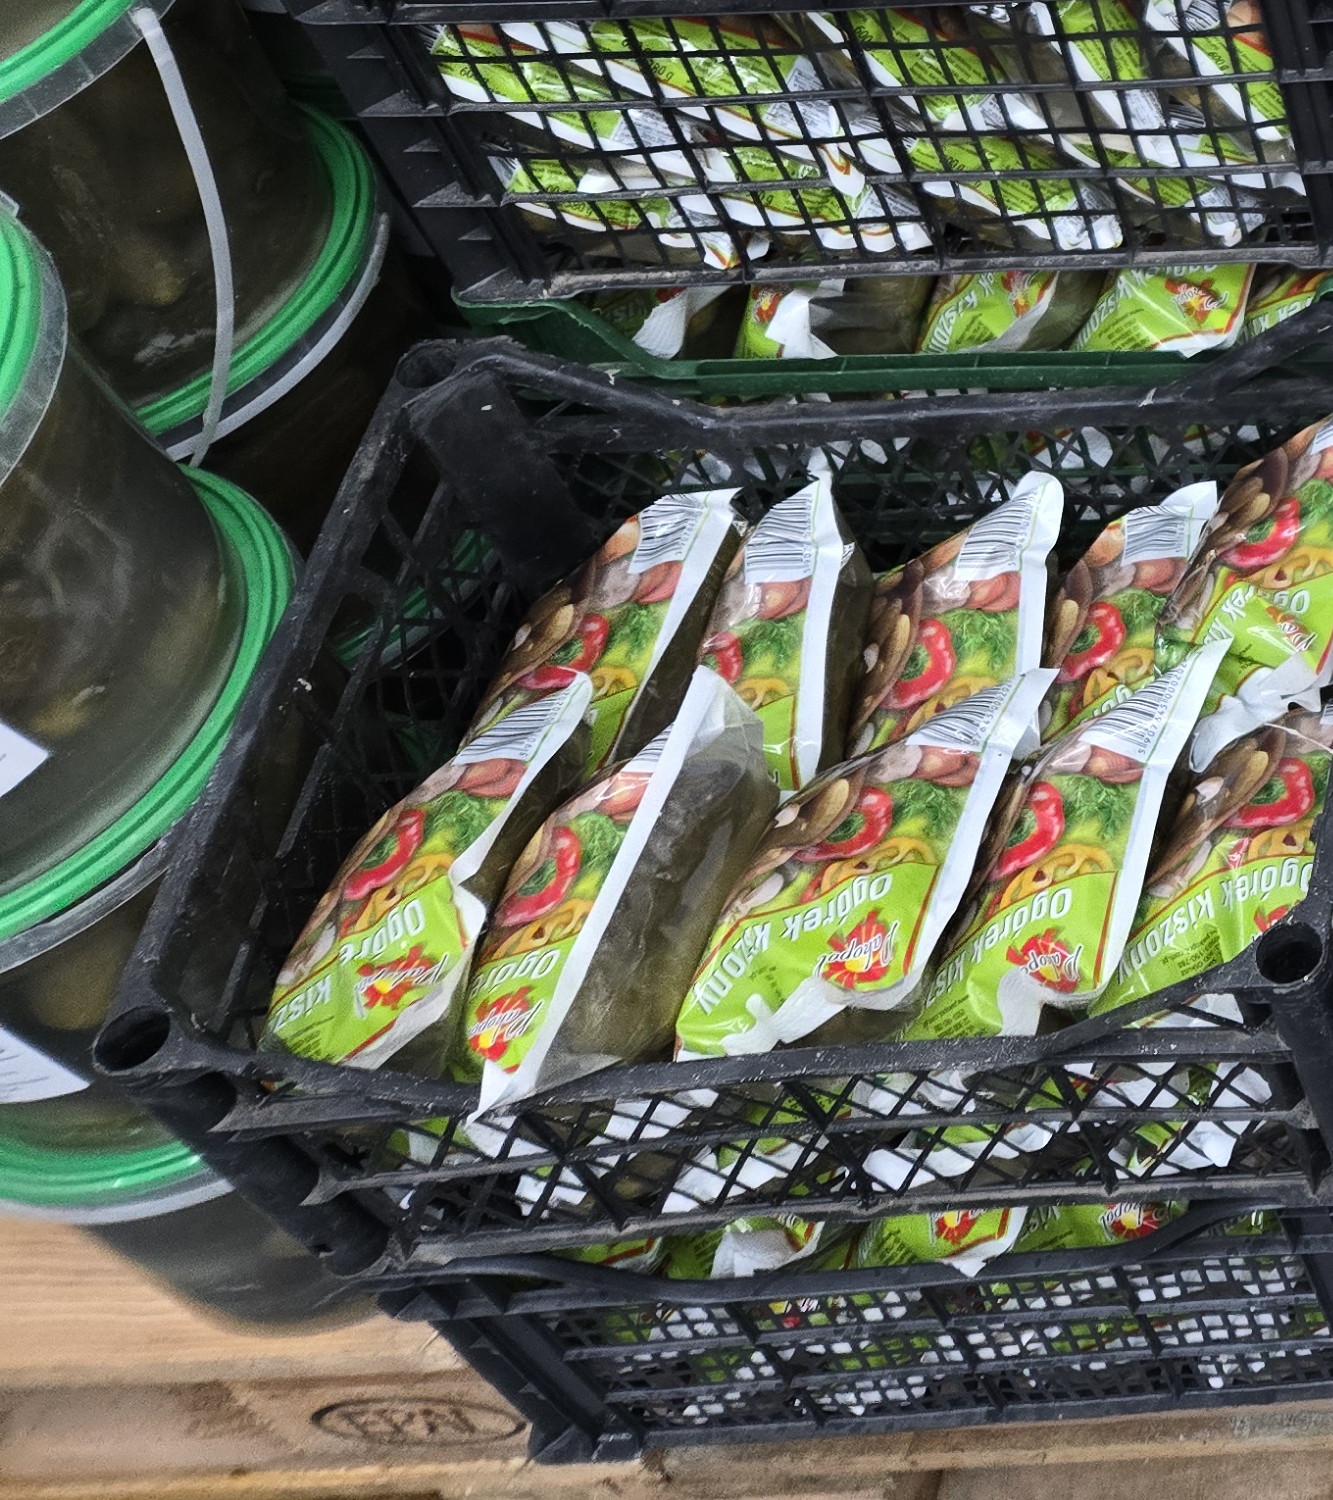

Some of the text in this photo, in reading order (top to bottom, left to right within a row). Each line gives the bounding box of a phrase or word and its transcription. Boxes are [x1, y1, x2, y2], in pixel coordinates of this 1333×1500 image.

[780, 871, 895, 942] Ogórek
[970, 885, 1073, 964] Ogórek
[813, 917, 902, 979] Pakopol
